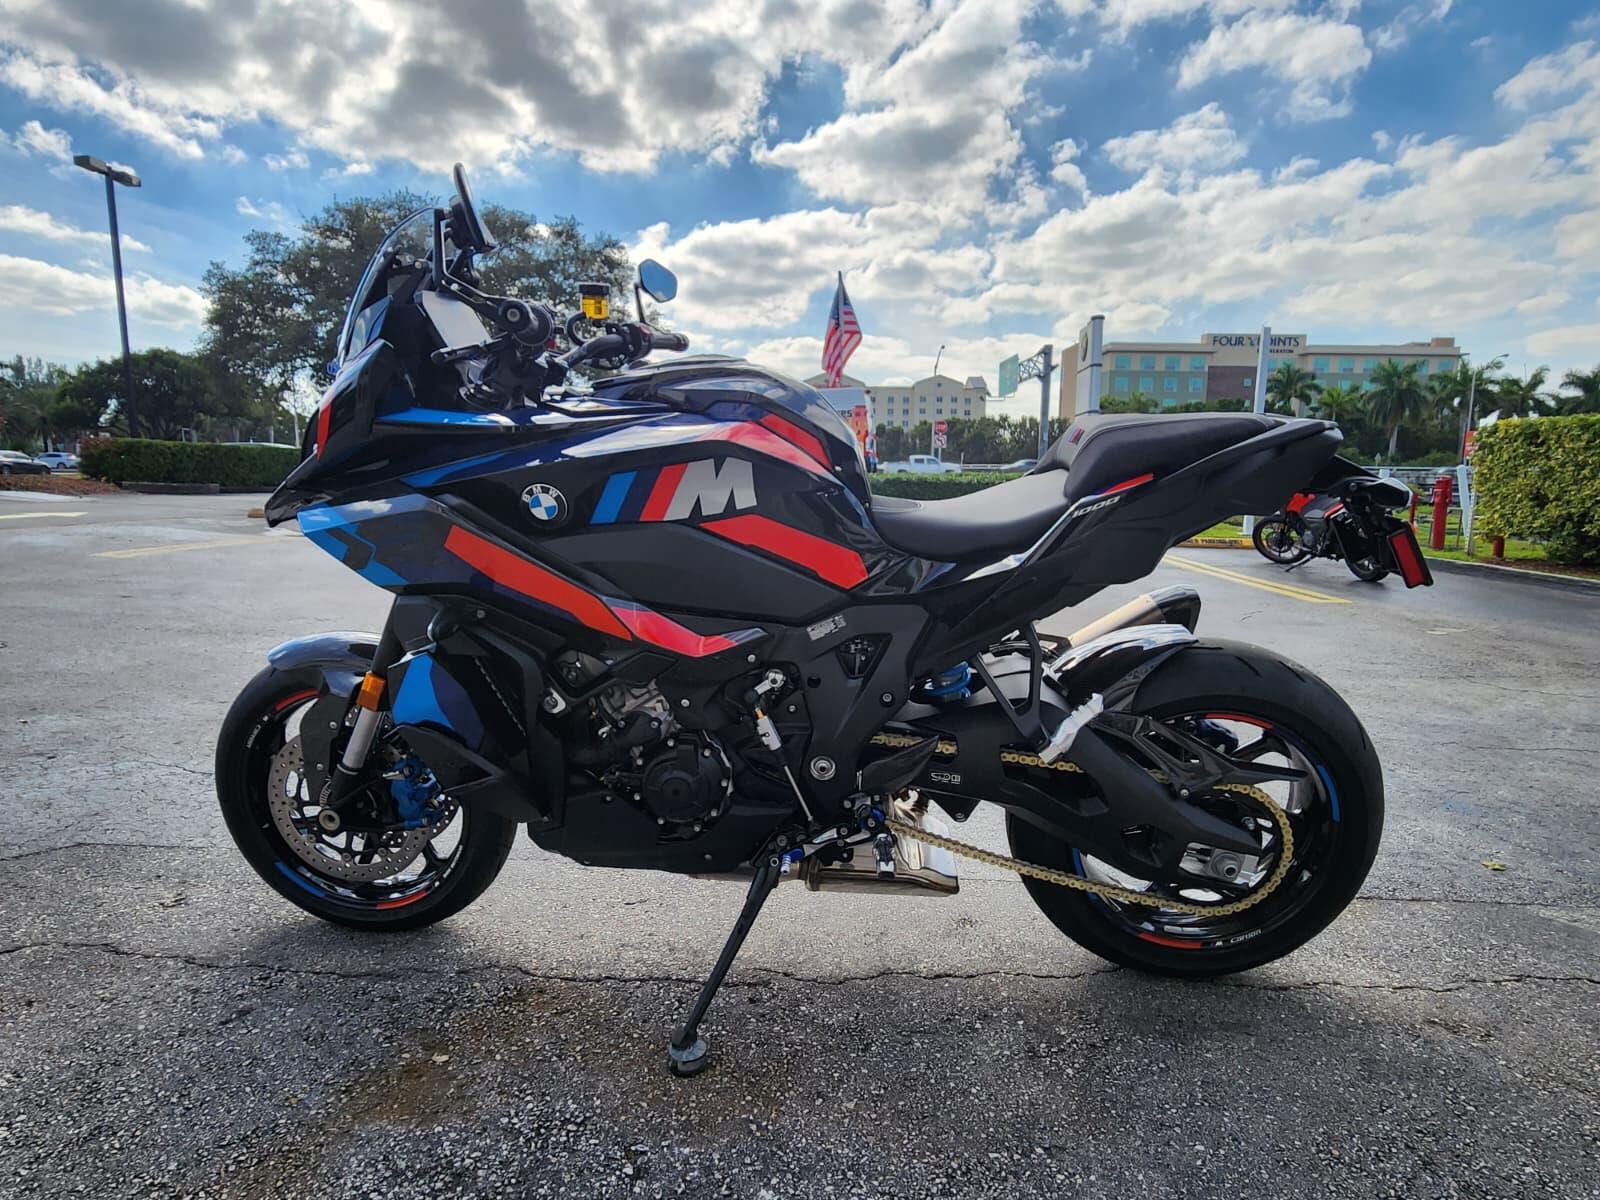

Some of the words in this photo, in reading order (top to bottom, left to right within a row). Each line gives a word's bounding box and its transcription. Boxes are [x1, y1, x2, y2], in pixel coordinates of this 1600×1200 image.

[1212, 335, 1244, 347] FOUR
[1257, 335, 1300, 347] INTS
[521, 485, 560, 503] BMW
[662, 456, 758, 521] M
